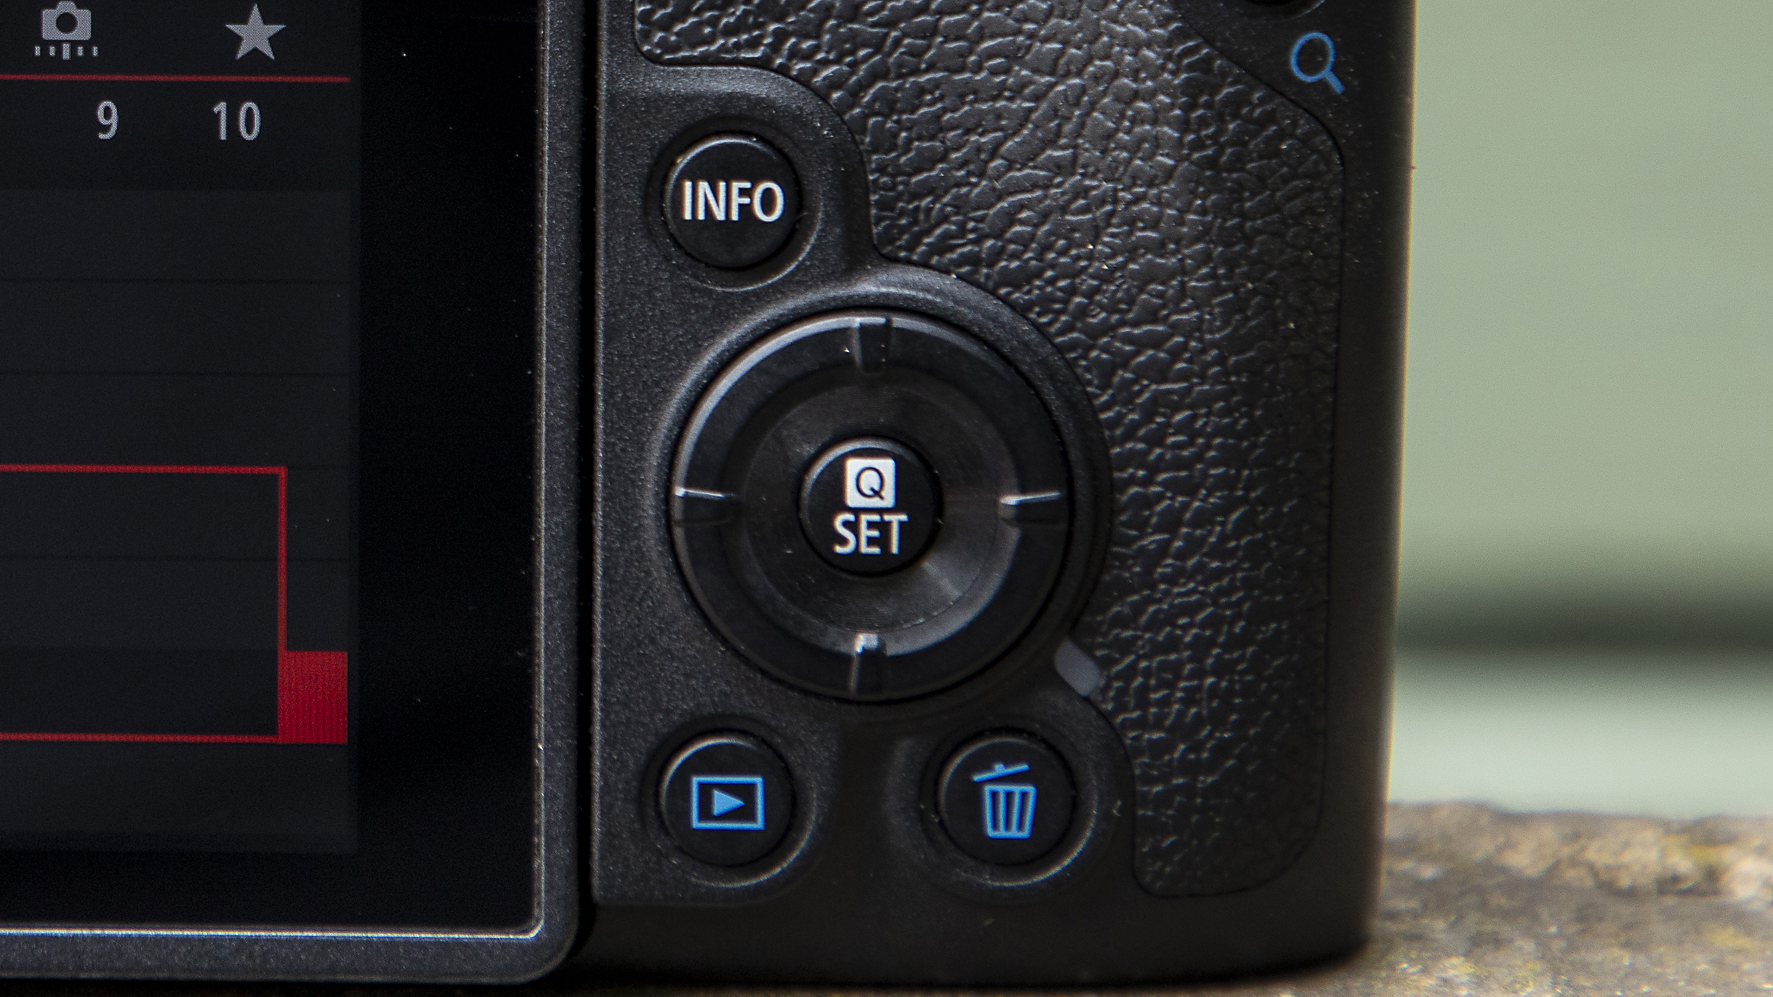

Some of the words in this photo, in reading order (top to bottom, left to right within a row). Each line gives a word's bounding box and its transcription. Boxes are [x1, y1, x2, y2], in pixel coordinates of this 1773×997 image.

[96, 100, 118, 140] 9
[213, 101, 261, 141] 10
[683, 180, 785, 223] INFO
[854, 466, 887, 500] Q
[833, 512, 909, 555] SET
